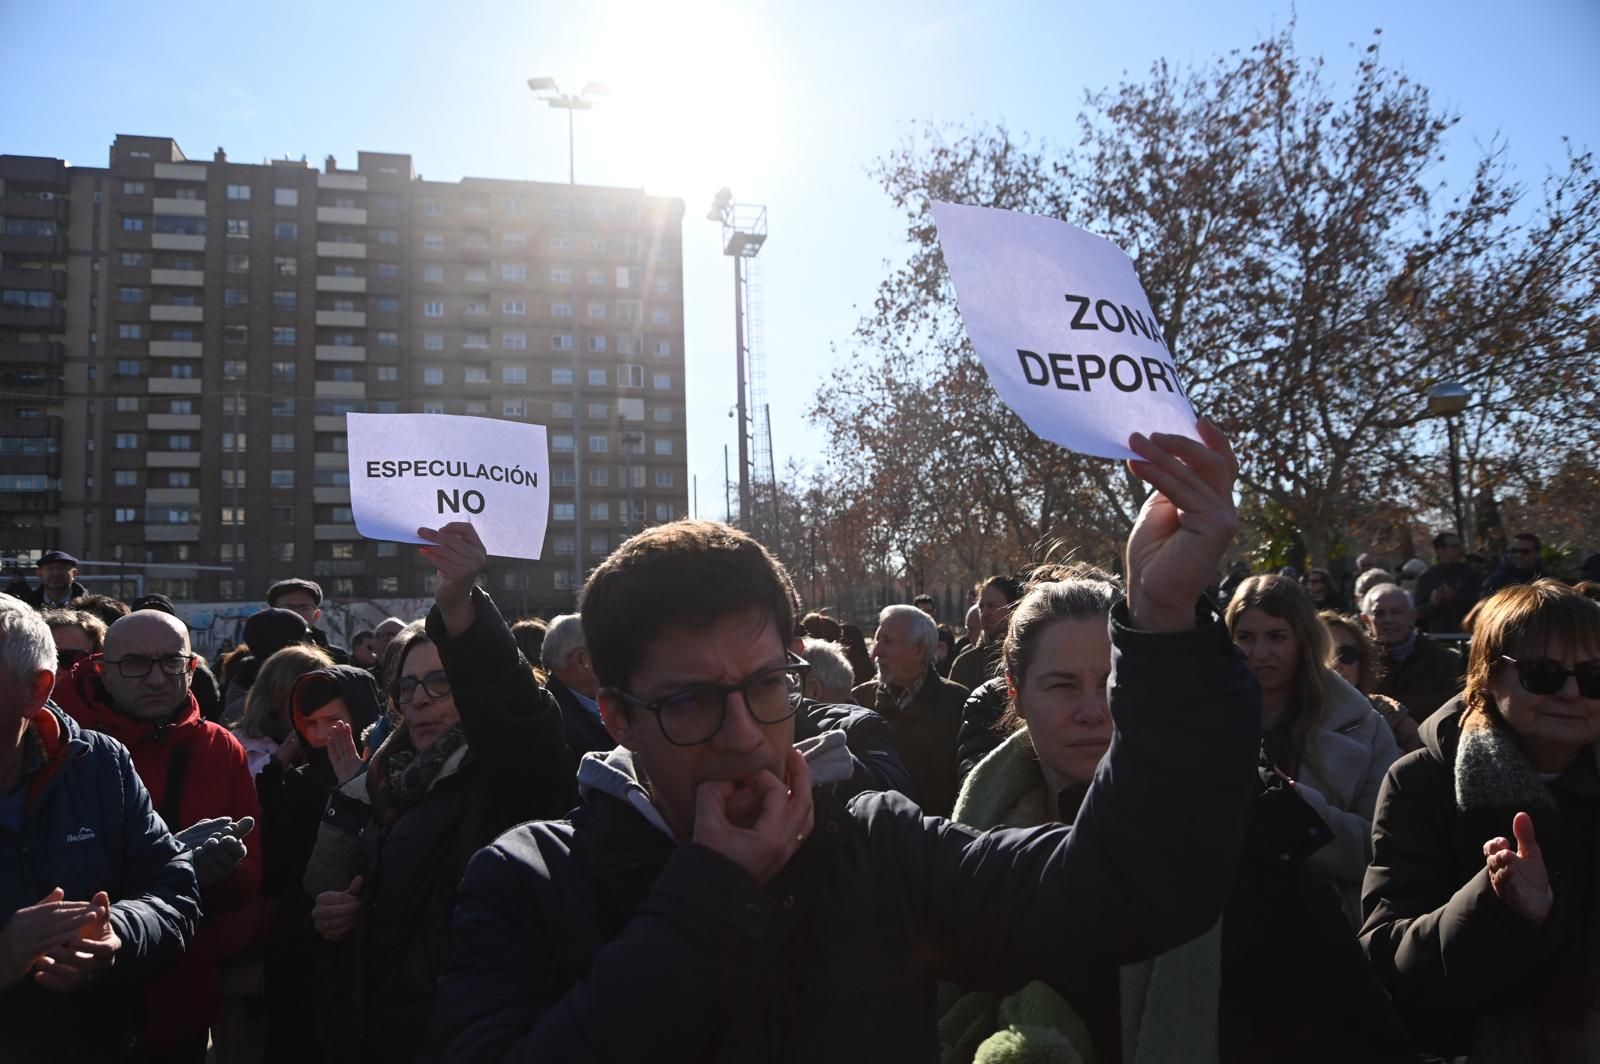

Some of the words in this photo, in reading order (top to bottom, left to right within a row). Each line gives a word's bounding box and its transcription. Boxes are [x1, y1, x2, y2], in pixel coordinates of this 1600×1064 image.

[1065, 294, 1167, 349] ZONA
[366, 460, 538, 488] ESPECULACIÓN
[436, 489, 486, 515] NO
